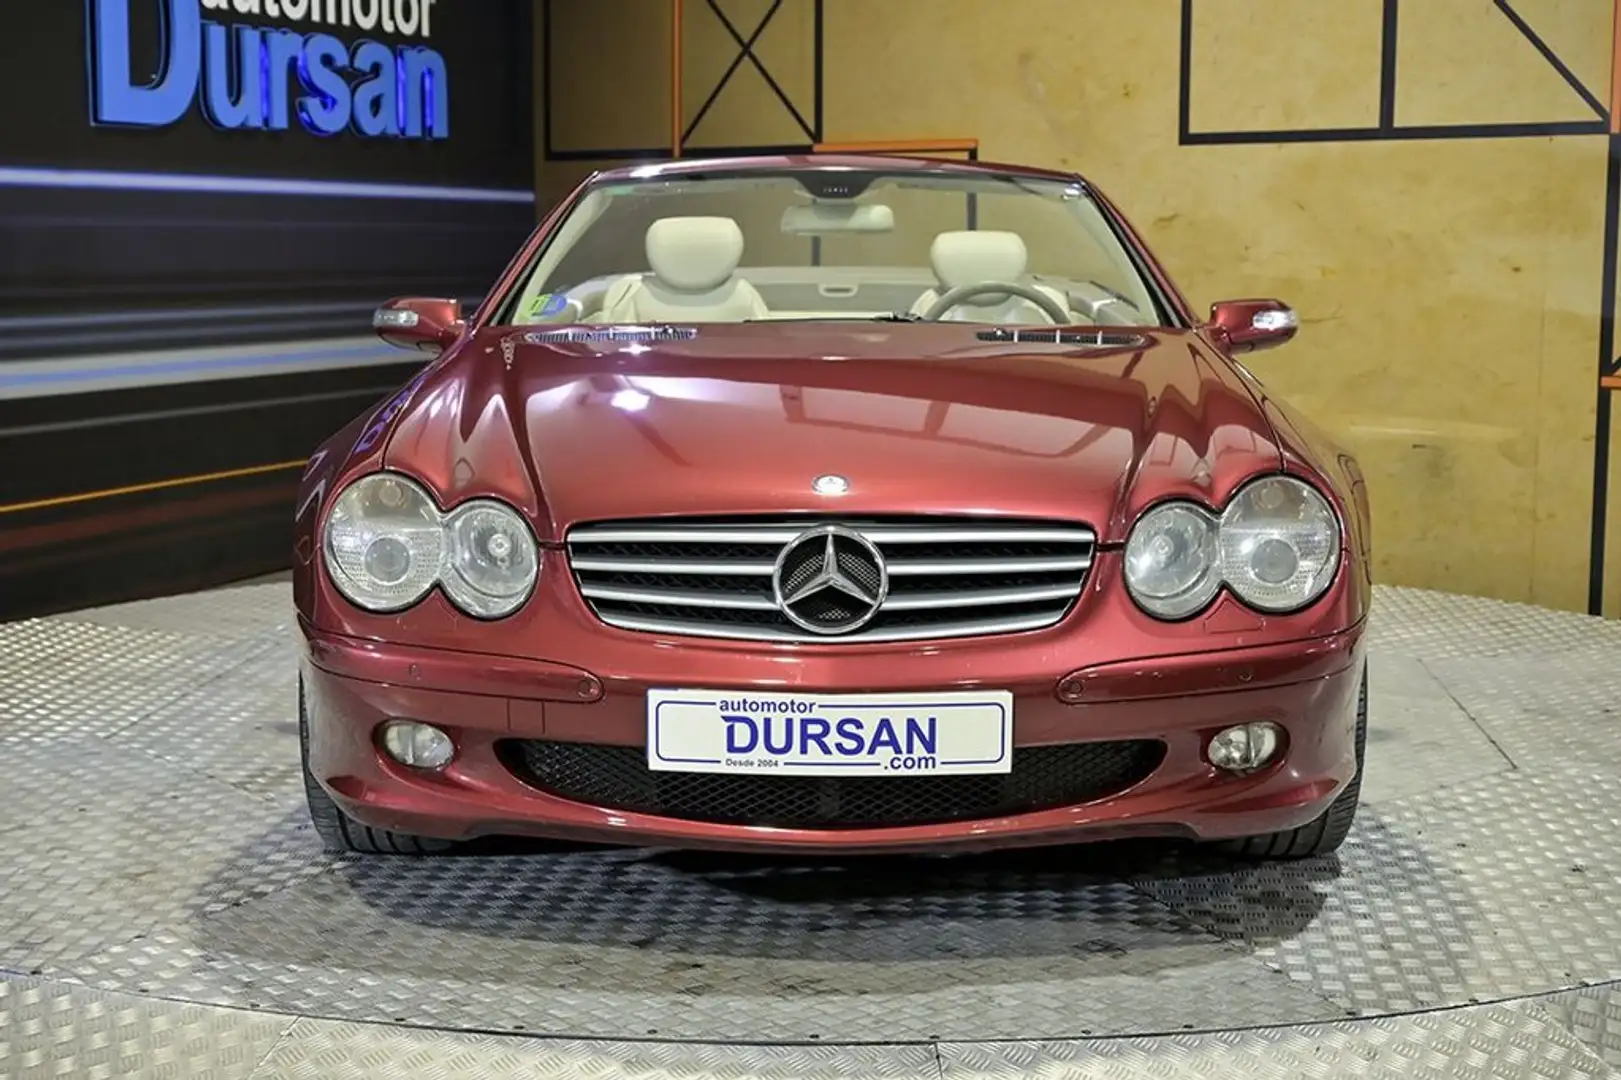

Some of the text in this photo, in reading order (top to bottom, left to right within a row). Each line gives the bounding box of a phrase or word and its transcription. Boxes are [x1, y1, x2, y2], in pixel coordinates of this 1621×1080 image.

[201, 0, 437, 38] motor
[86, 0, 450, 139] Dursan
[719, 698, 816, 714] automotor
[720, 715, 937, 756] DURSAN
[725, 758, 779, 768] Desde 2004
[884, 756, 936, 770] .com
